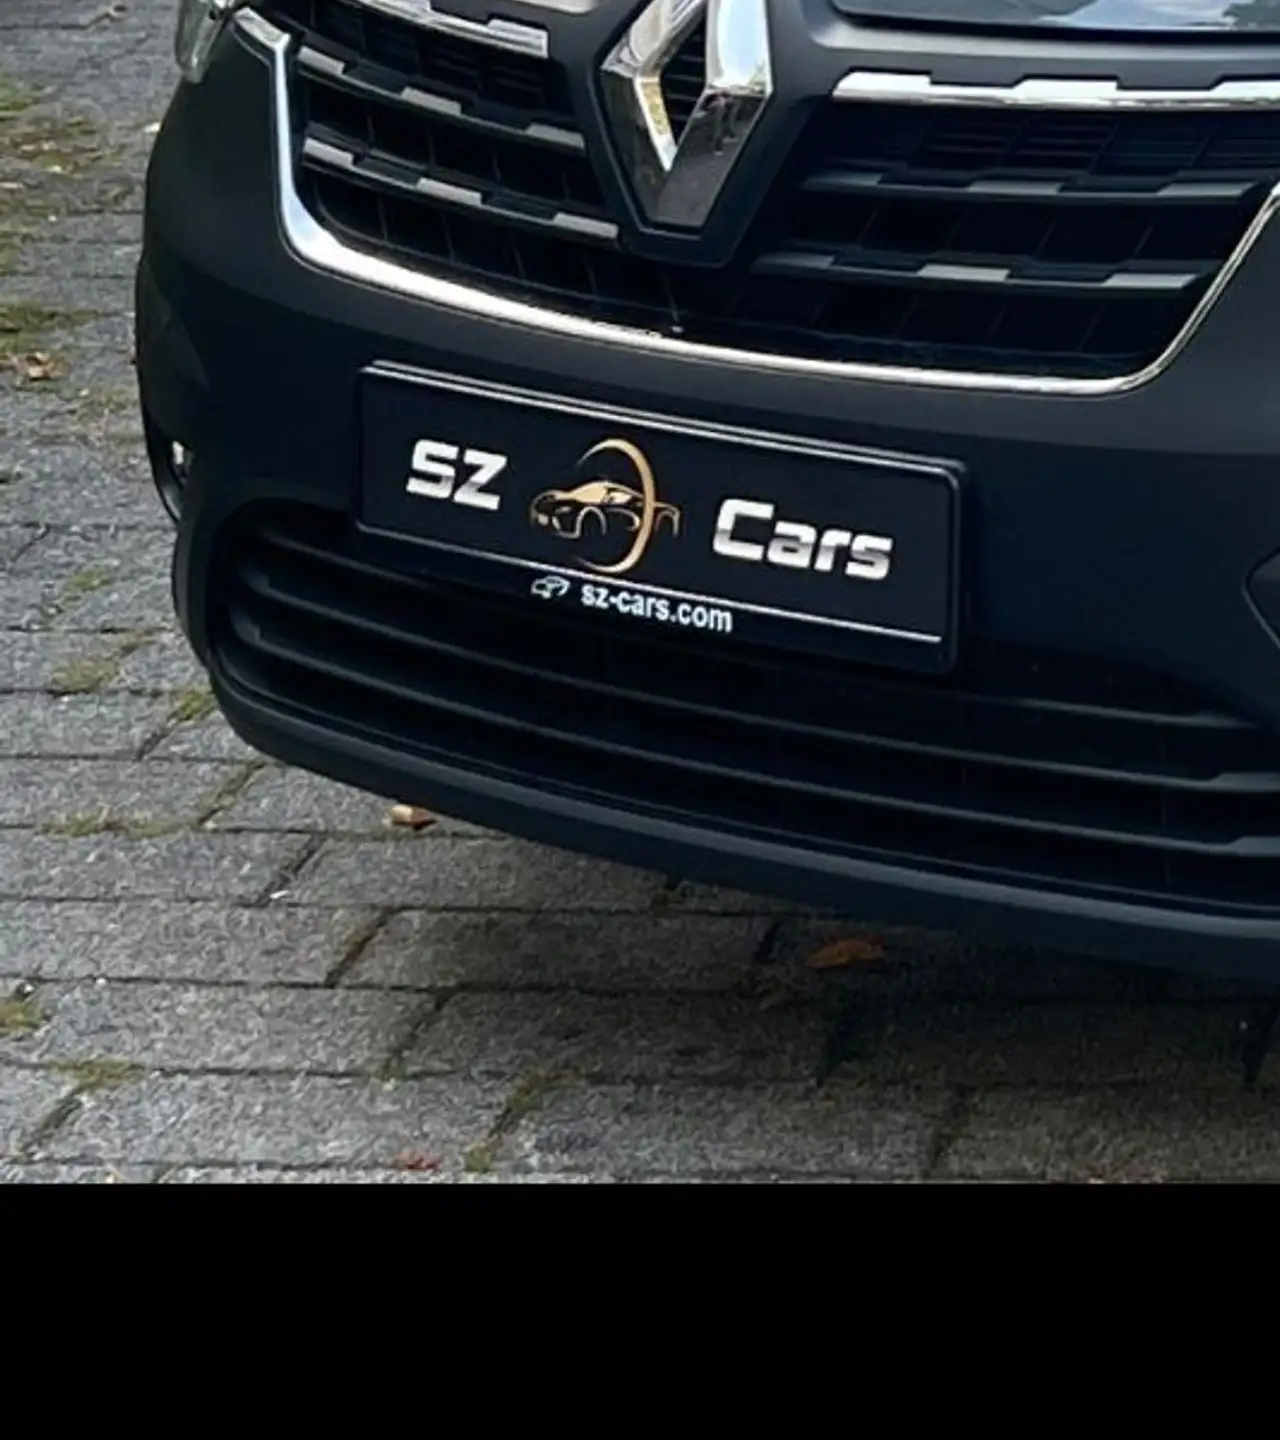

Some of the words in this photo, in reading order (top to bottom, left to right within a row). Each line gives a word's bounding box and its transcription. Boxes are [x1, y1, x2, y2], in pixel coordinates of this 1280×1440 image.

[406, 439, 507, 510] SZ
[712, 498, 894, 580] Cars
[581, 581, 733, 633] sz-cars.com
